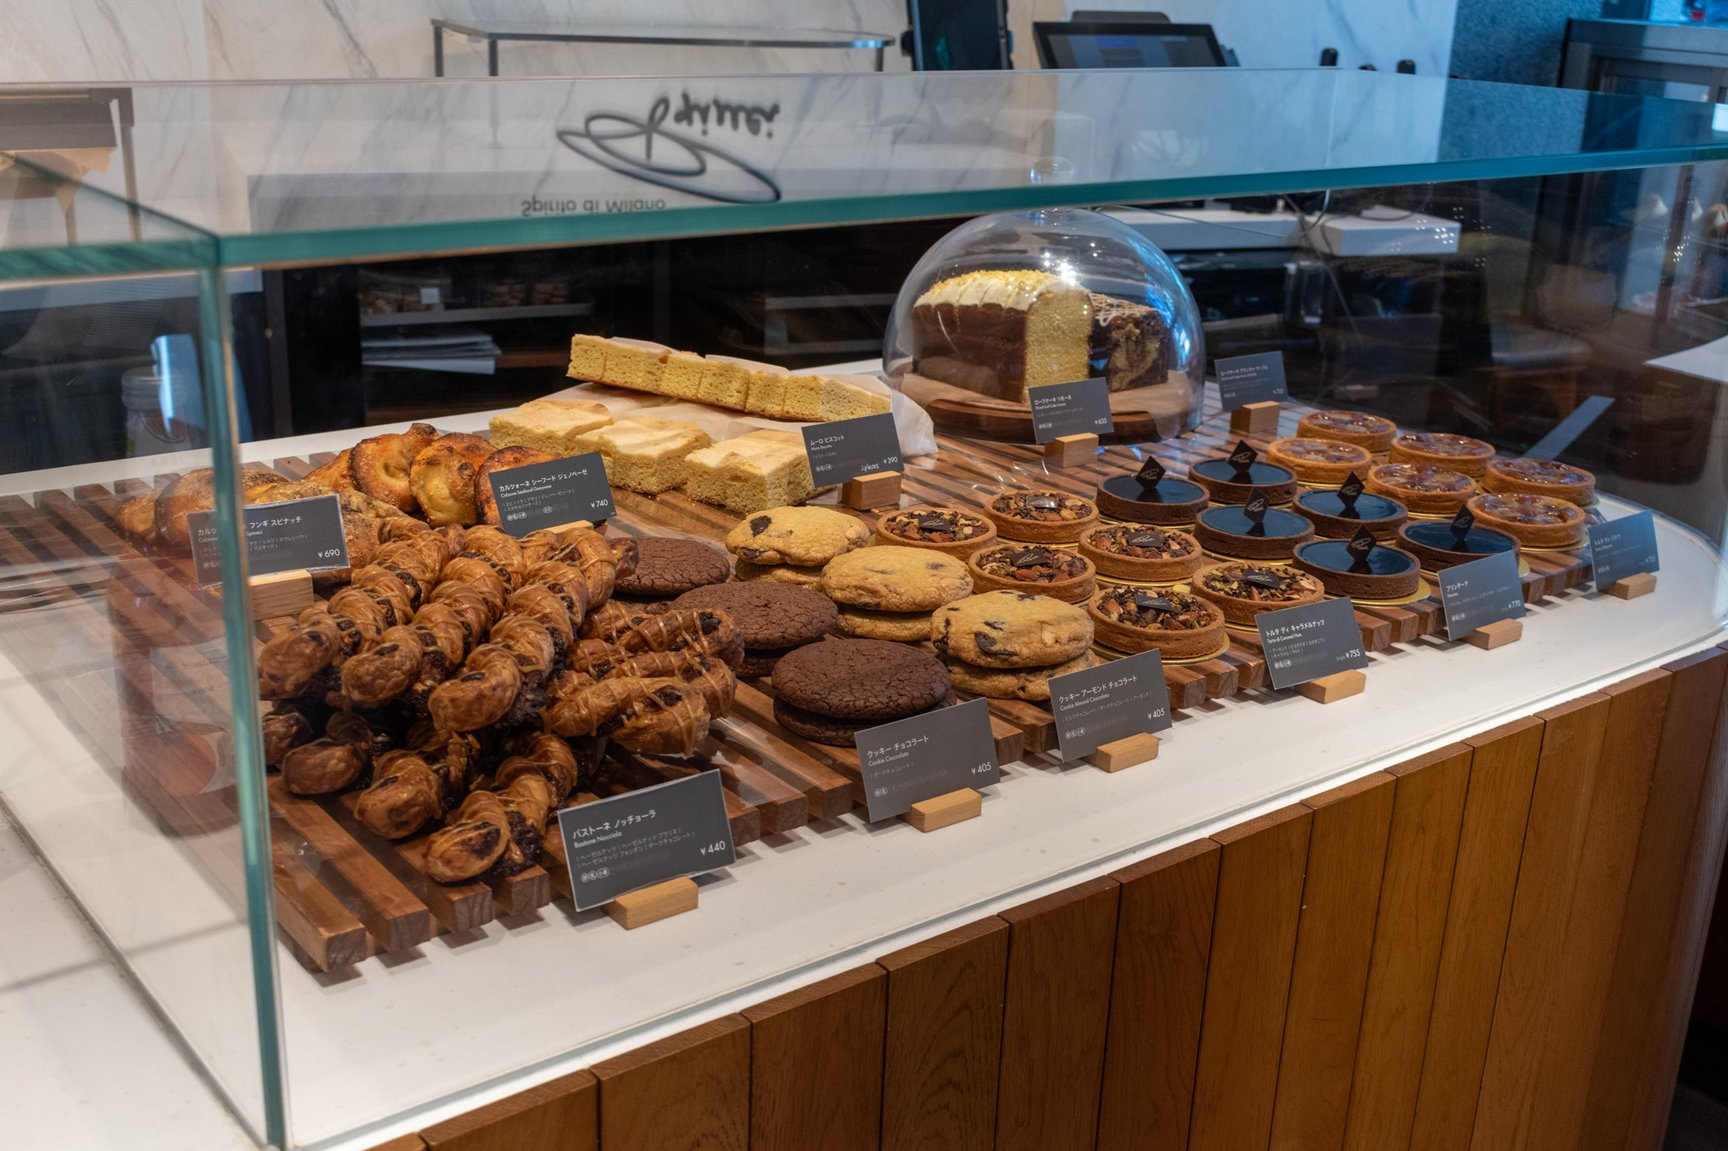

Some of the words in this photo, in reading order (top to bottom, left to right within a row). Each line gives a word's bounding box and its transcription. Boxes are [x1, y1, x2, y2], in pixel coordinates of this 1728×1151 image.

[499, 480, 530, 492] カルツォーネ
[531, 475, 557, 486] シーフード
[558, 468, 588, 481] ジェノベーゼ
[590, 498, 609, 509] ¥740
[249, 519, 269, 529] フンギ
[317, 548, 341, 559] ¥690
[1059, 693, 1080, 704] クッキー
[1081, 683, 1107, 697] アーモンド
[1108, 674, 1138, 690] チョコラート
[1147, 707, 1165, 720] ¥405
[867, 746, 892, 759] クッキー
[894, 735, 929, 752] チョコラート
[971, 761, 992, 775] ¥405
[572, 821, 612, 840] バストーネ
[614, 809, 656, 829] ノッチョーラ
[700, 840, 726, 856] ¥440
